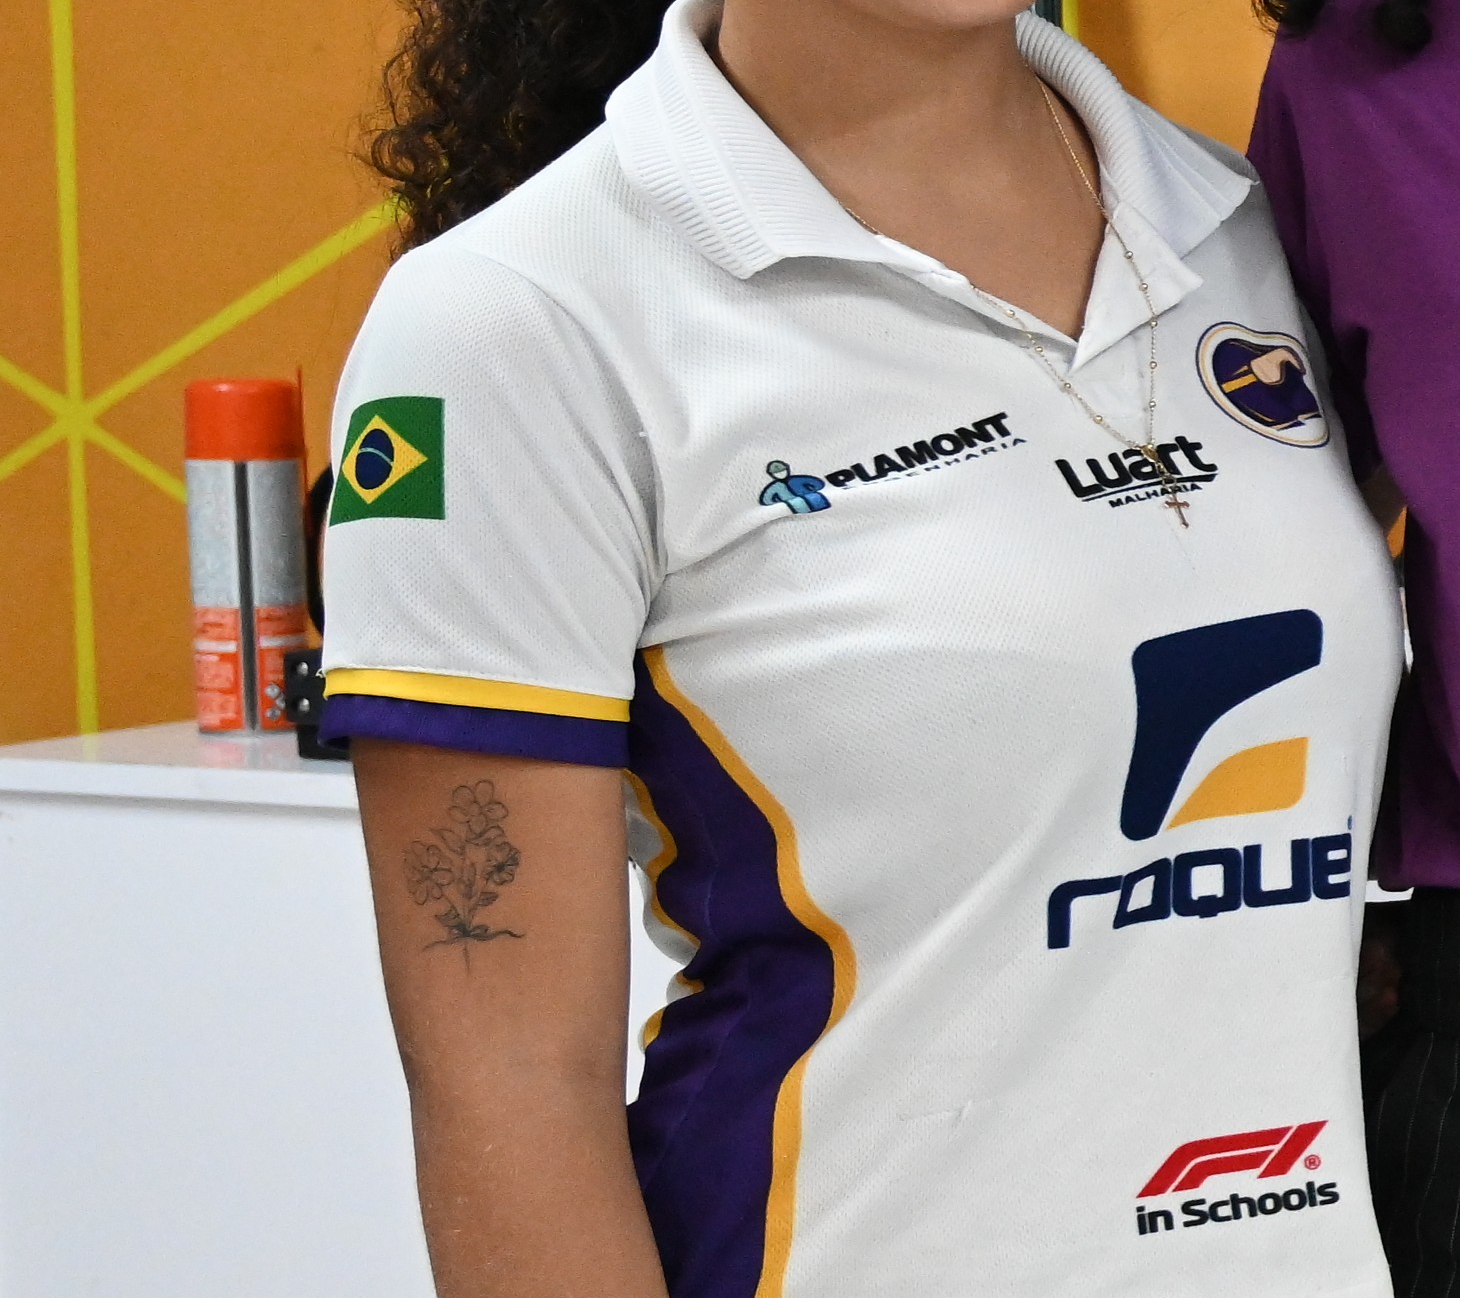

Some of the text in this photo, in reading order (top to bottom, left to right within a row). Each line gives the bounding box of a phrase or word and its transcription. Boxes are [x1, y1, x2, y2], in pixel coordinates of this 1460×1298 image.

[825, 411, 1011, 488] PLAMONT
[1055, 436, 1218, 498] Luart
[1136, 1180, 1341, 1236] in Schools
